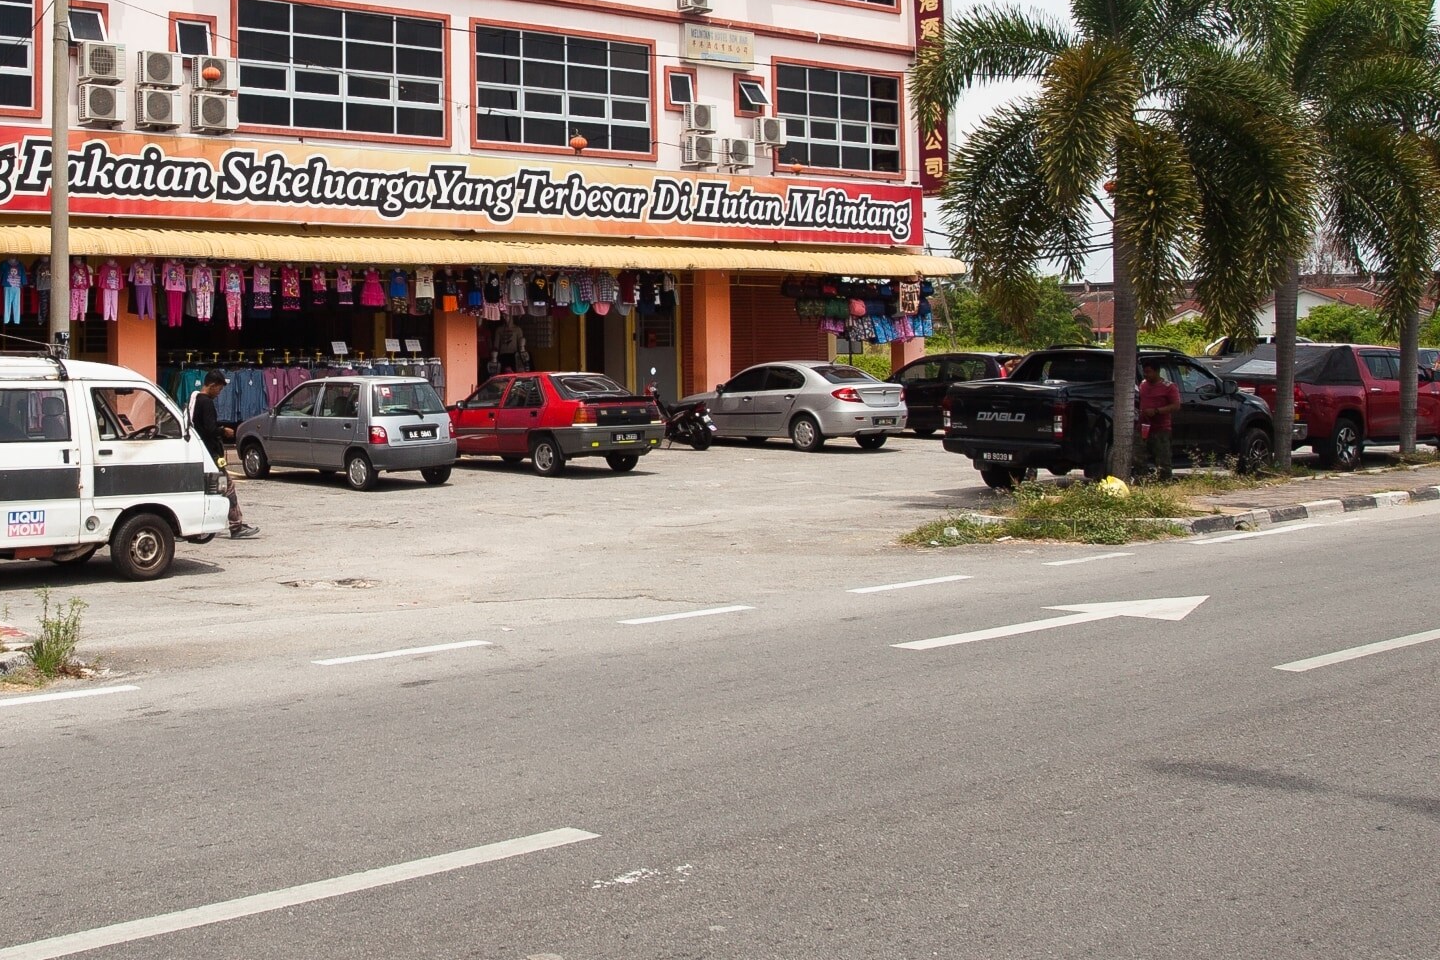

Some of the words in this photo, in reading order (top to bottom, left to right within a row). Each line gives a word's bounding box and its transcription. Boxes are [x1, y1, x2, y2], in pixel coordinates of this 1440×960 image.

[24, 141, 211, 193] Pakaian
[221, 154, 429, 211] Sekeluarga
[435, 169, 514, 218] Yang
[522, 173, 646, 212] Terbesar
[655, 181, 691, 219] Di
[698, 187, 782, 221] Hutan
[787, 194, 910, 234] Melintang
[976, 411, 1025, 422] DIABLO
[9, 511, 44, 524] LIQUI
[8, 524, 44, 536] MOLY
